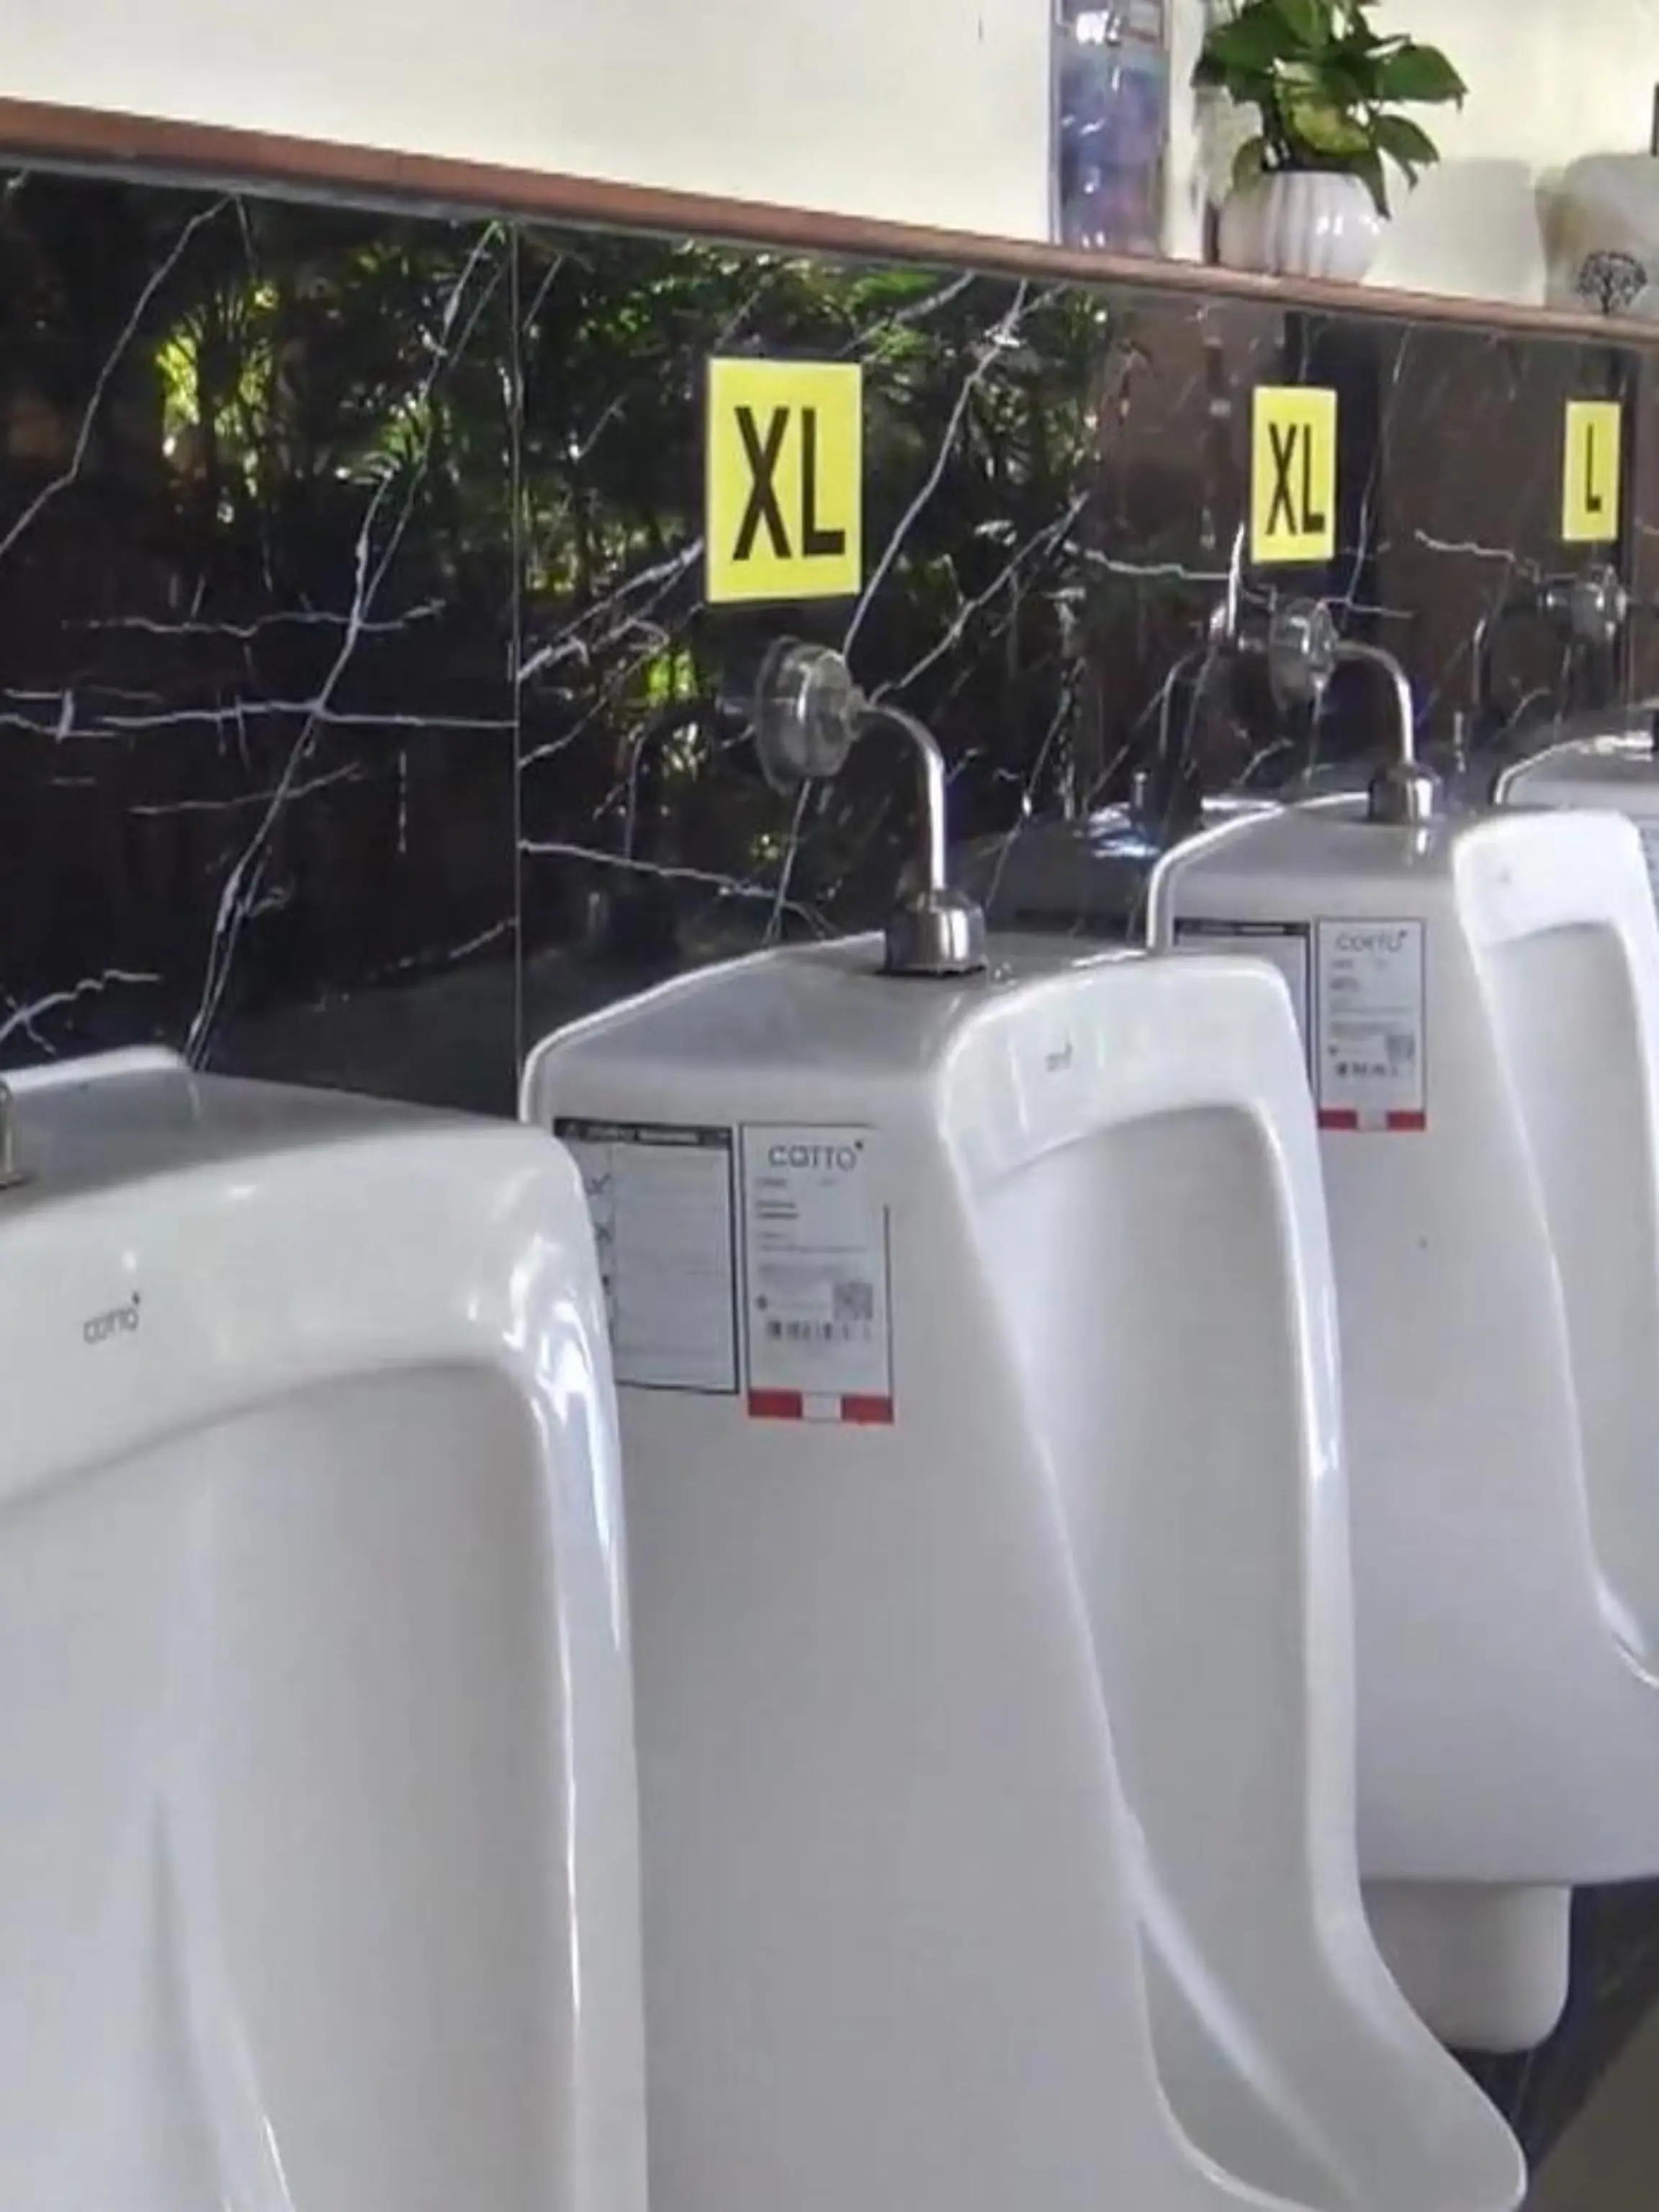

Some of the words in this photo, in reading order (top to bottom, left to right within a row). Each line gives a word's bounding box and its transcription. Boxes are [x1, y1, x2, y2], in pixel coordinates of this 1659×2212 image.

[733, 407, 845, 561] XL
[1266, 423, 1325, 536] XL
[1586, 424, 1601, 513] L
